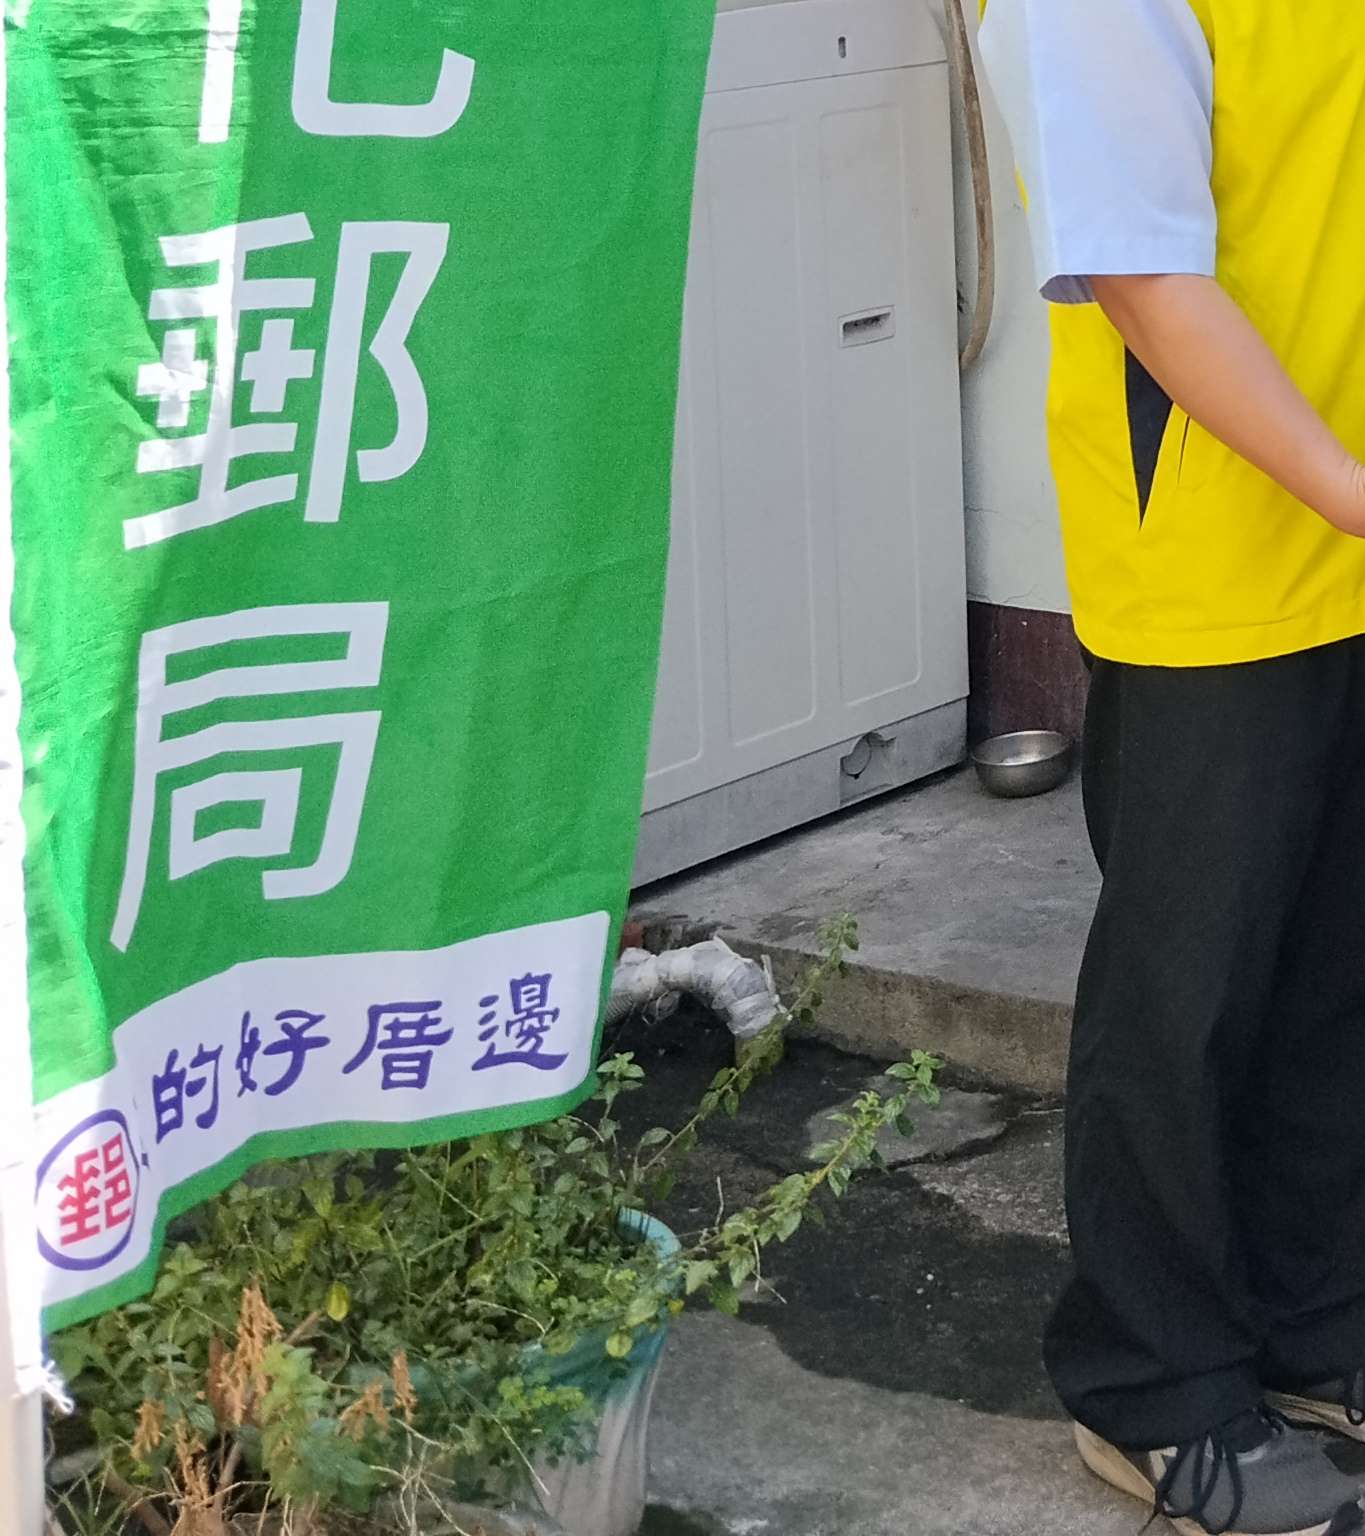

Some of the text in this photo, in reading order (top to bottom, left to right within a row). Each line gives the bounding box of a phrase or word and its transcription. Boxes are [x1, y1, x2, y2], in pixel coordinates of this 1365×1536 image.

[137, 972, 570, 1167] 的好厝邊
[57, 1131, 132, 1247] 郵
